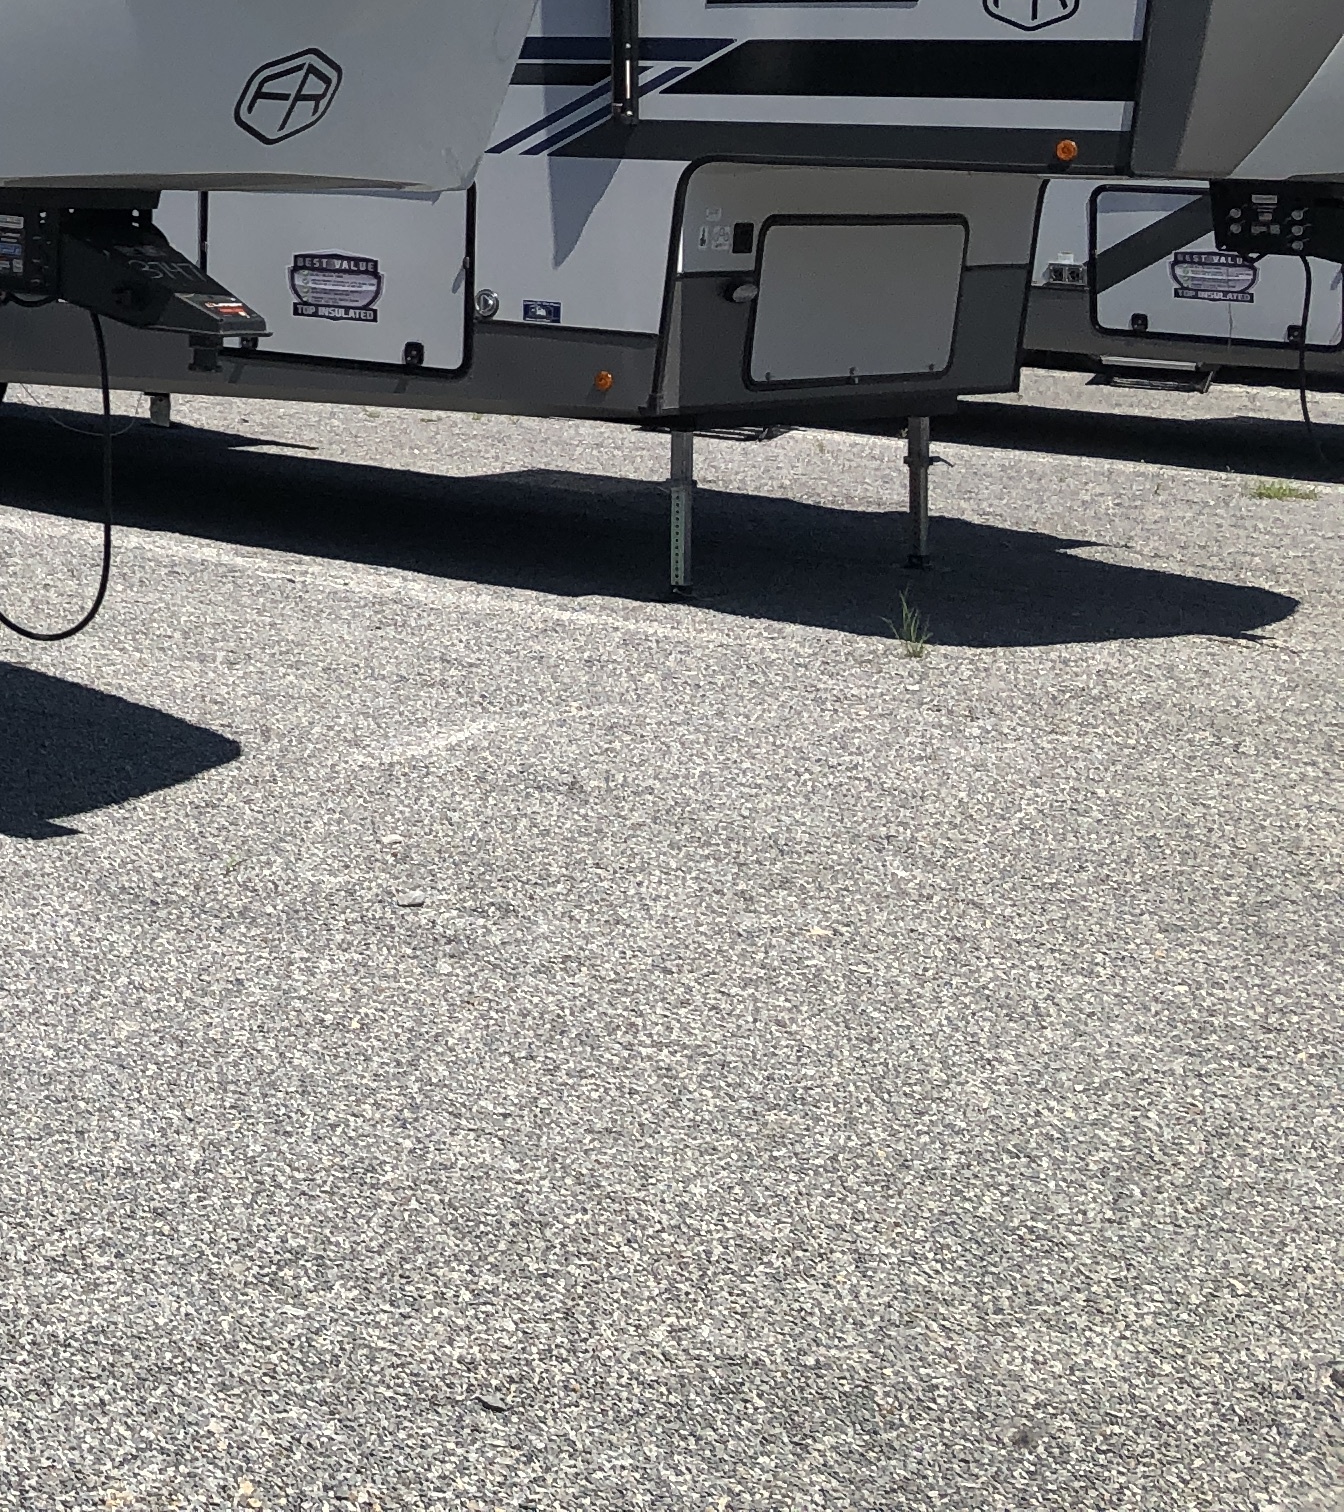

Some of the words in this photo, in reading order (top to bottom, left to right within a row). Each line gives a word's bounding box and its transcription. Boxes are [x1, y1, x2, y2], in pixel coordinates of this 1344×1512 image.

[296, 256, 328, 268] BEST
[333, 258, 375, 271] VALUE
[296, 304, 316, 316] TOP
[318, 306, 375, 320] INSULATED
